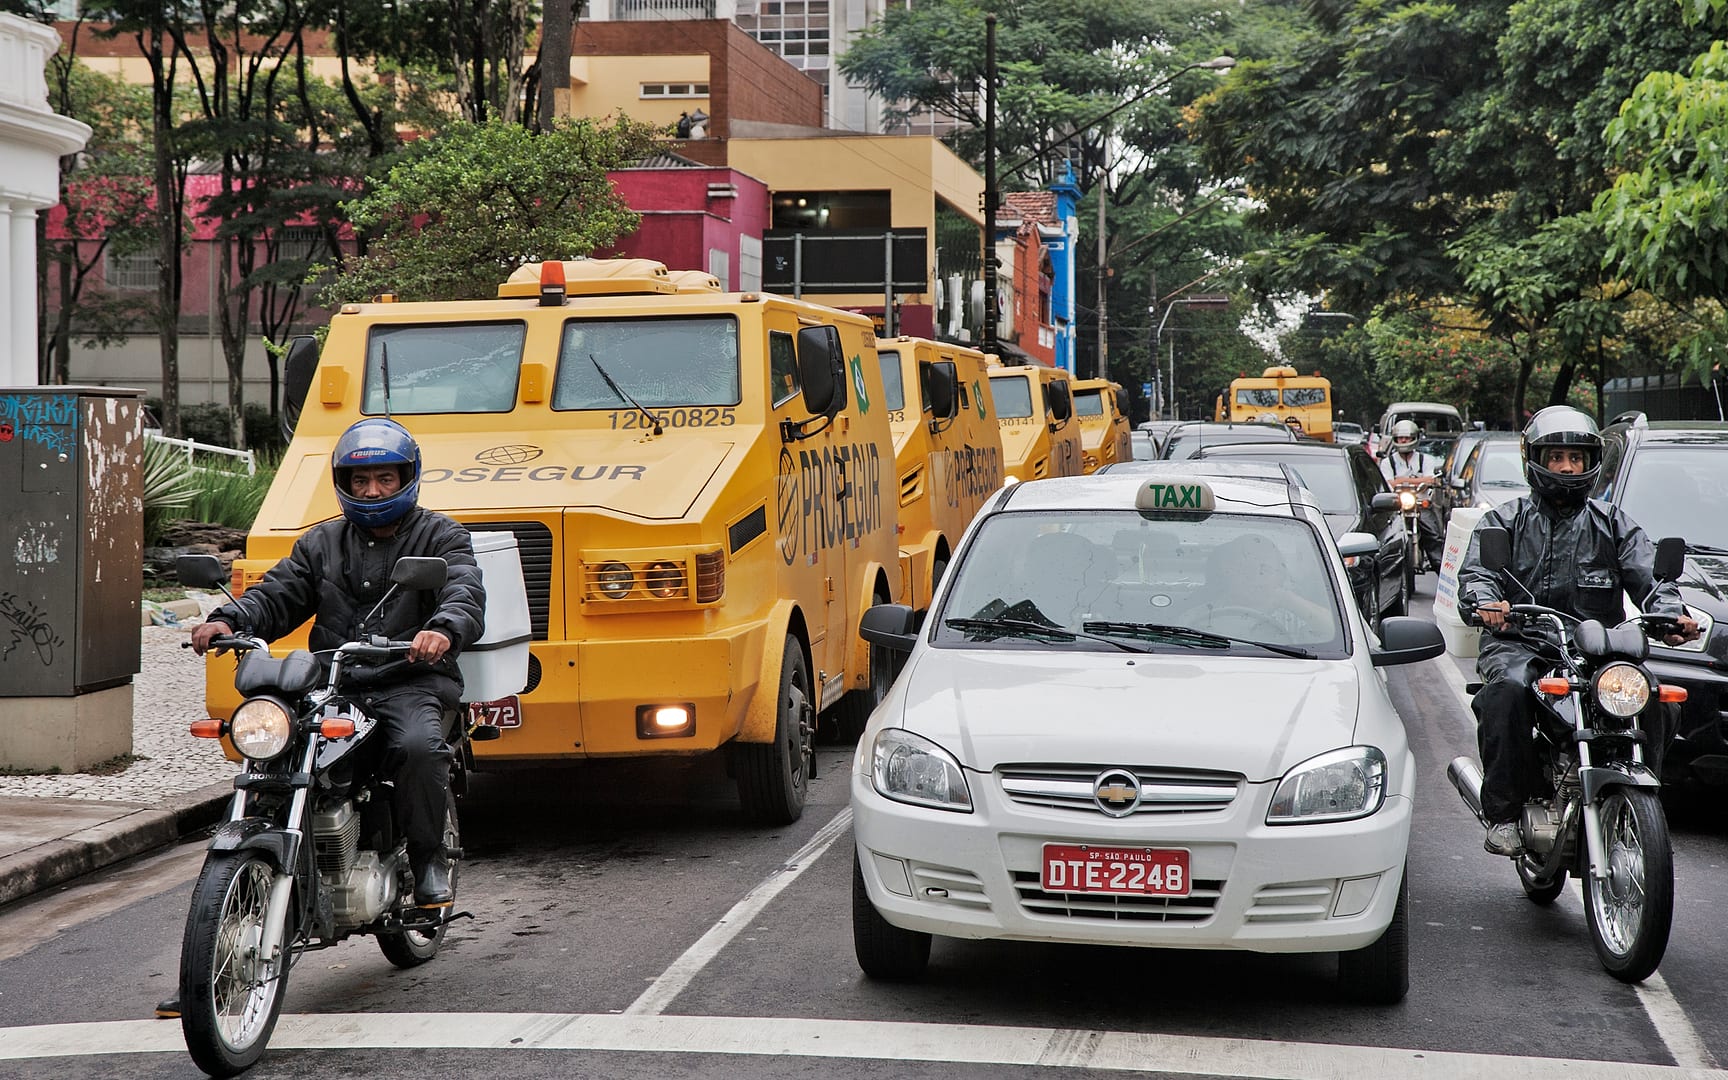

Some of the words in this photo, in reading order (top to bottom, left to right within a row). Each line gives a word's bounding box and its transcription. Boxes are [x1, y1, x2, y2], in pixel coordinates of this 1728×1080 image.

[608, 408, 736, 430] 12050825
[421, 465, 647, 483] OSEGUR
[799, 442, 881, 555] PROSEGUR
[1149, 485, 1201, 508] TAXI
[1123, 853, 1152, 862] PAULO
